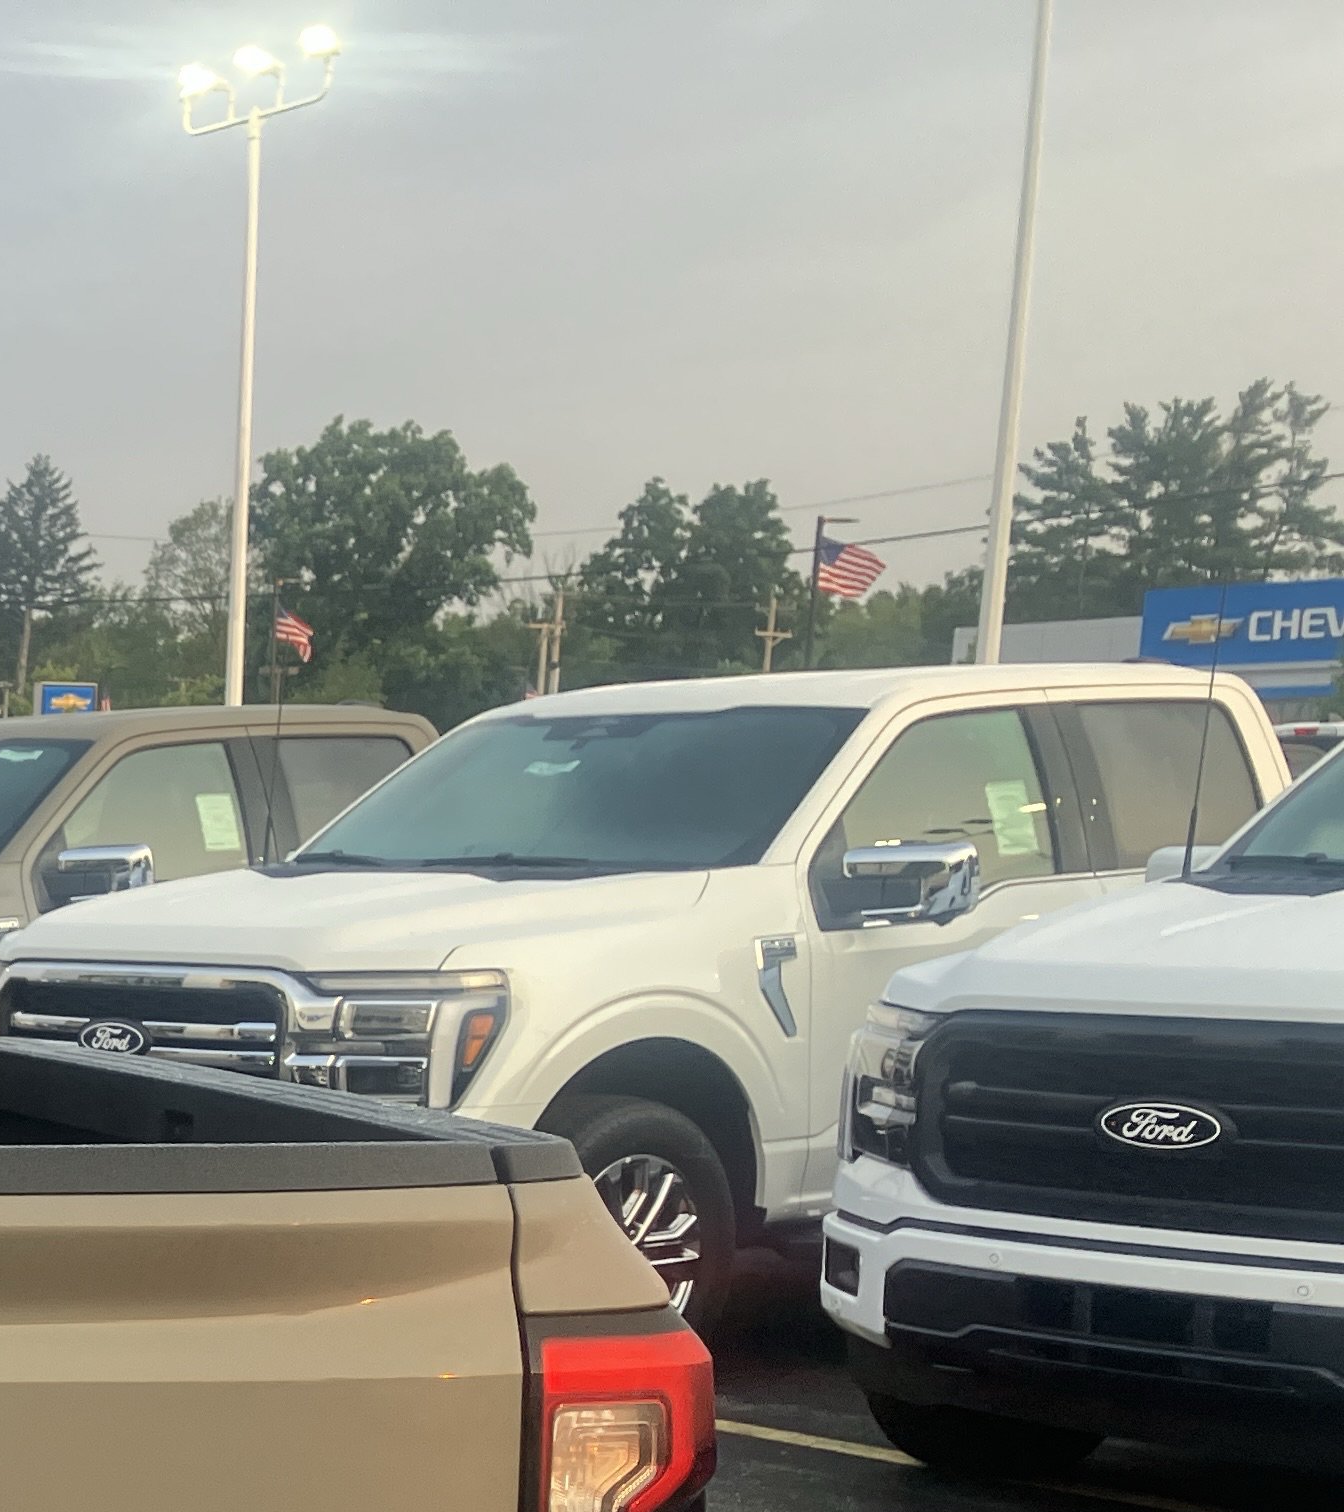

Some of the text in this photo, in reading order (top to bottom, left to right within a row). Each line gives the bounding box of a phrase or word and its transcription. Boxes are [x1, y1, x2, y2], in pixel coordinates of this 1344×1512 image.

[1247, 606, 1344, 642] CHEV
[91, 1026, 131, 1052] Ford
[1122, 1108, 1198, 1142] Ford
